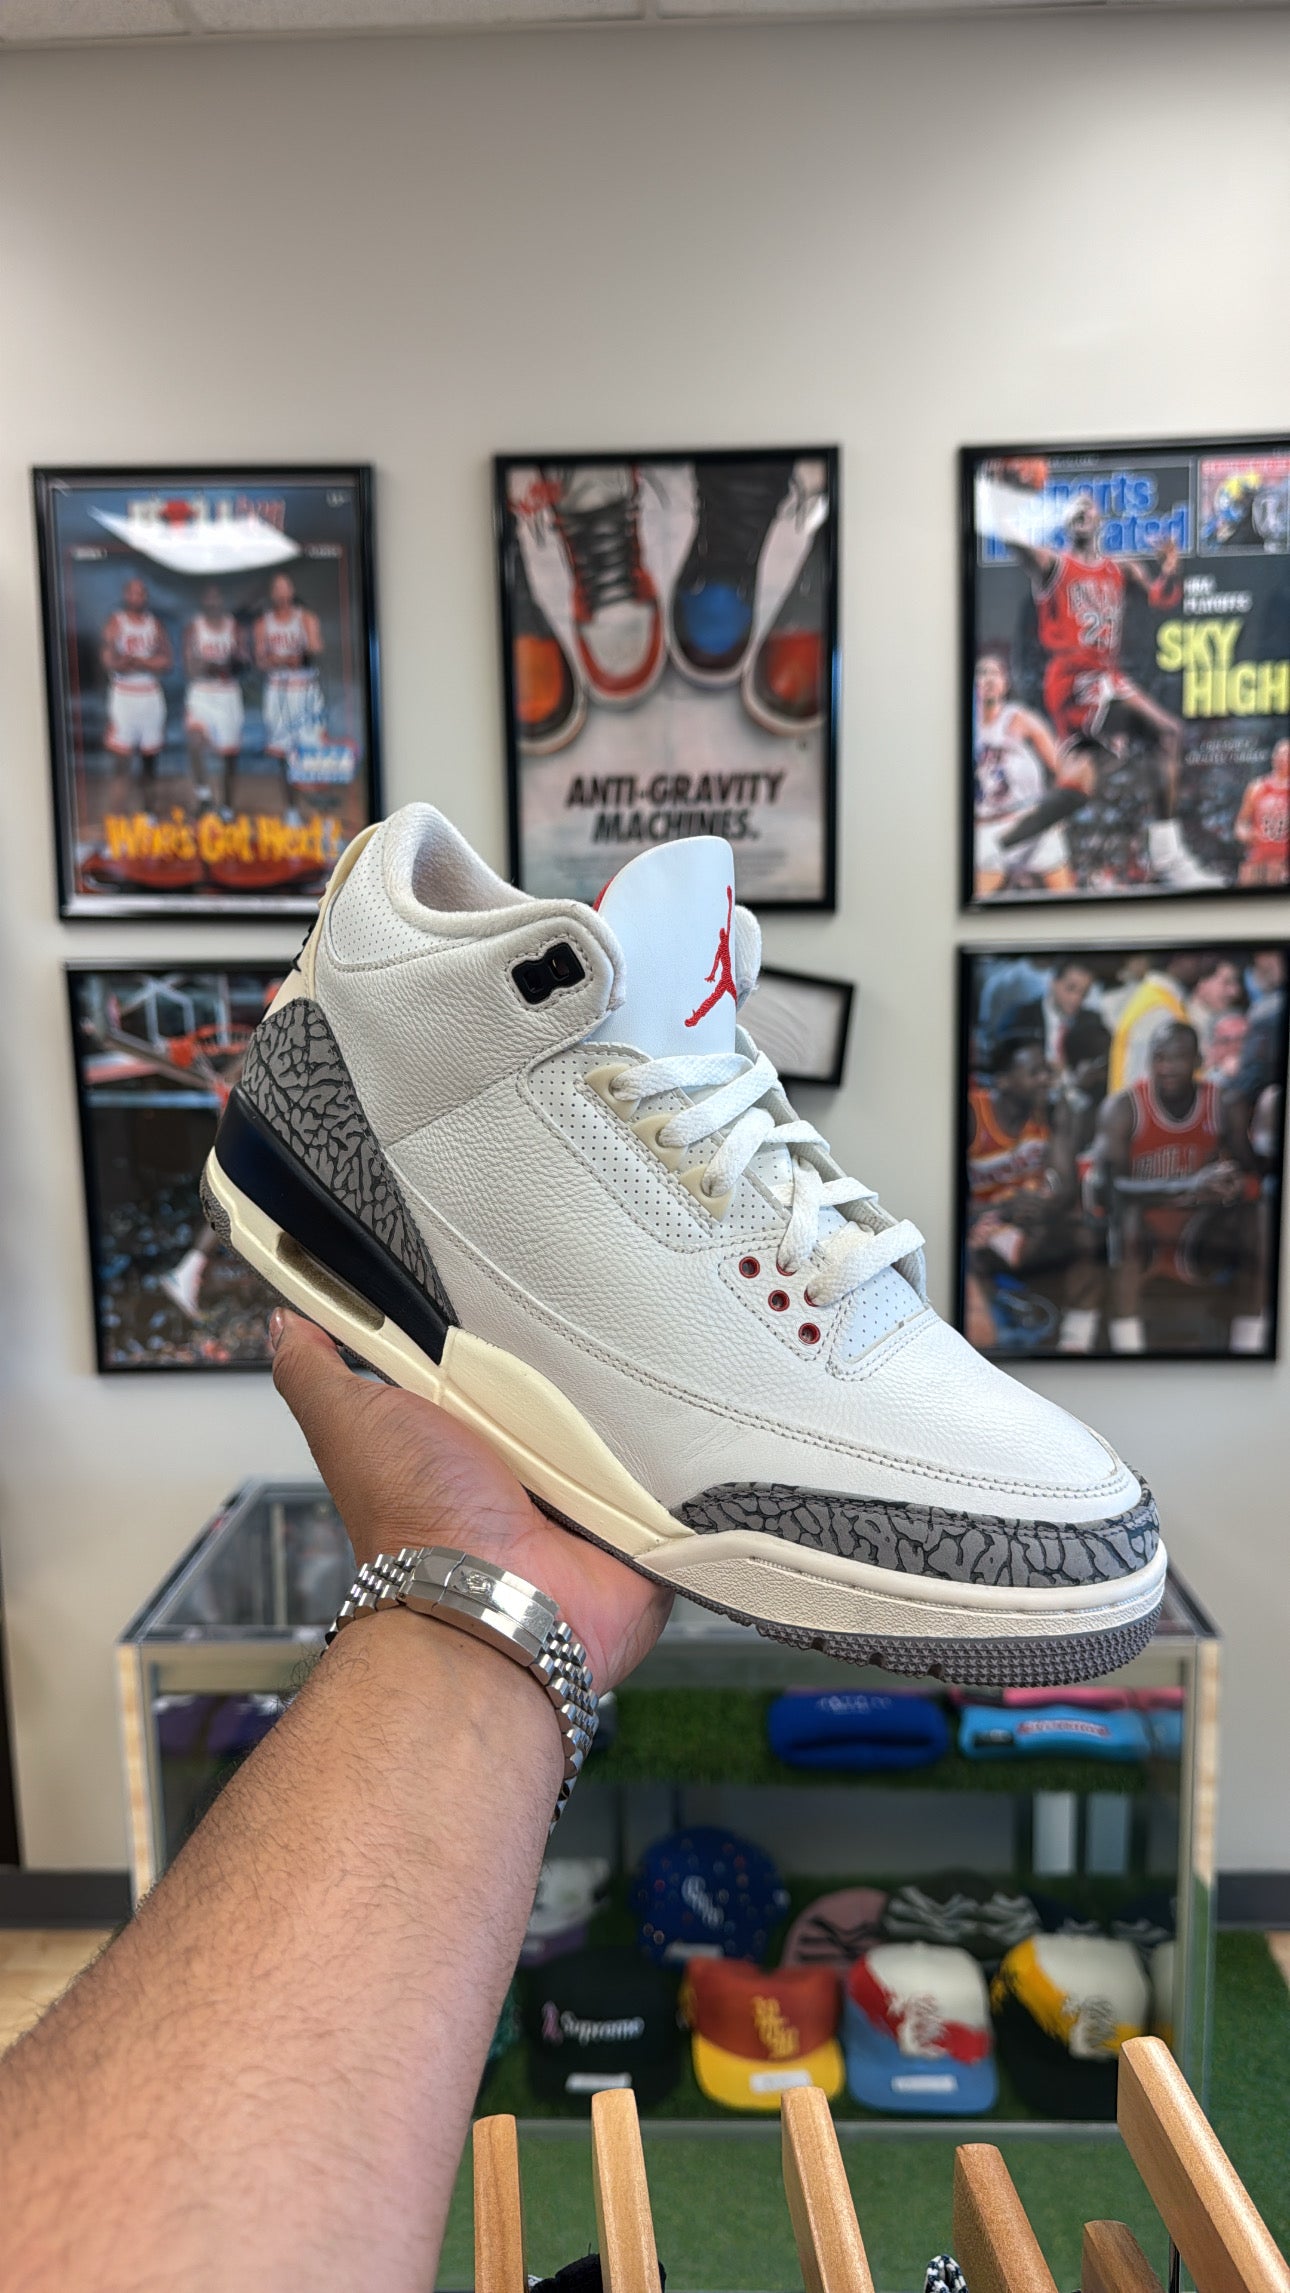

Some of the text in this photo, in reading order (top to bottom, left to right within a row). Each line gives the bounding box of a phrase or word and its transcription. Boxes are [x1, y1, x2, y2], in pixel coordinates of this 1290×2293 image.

[1156, 619, 1241, 671] SKY
[1182, 661, 1290, 719] HIGH
[566, 773, 786, 808] ANTI-GRAVITY
[104, 806, 196, 859] Who's
[199, 812, 254, 864] Got
[592, 807, 760, 843] MACHINES.
